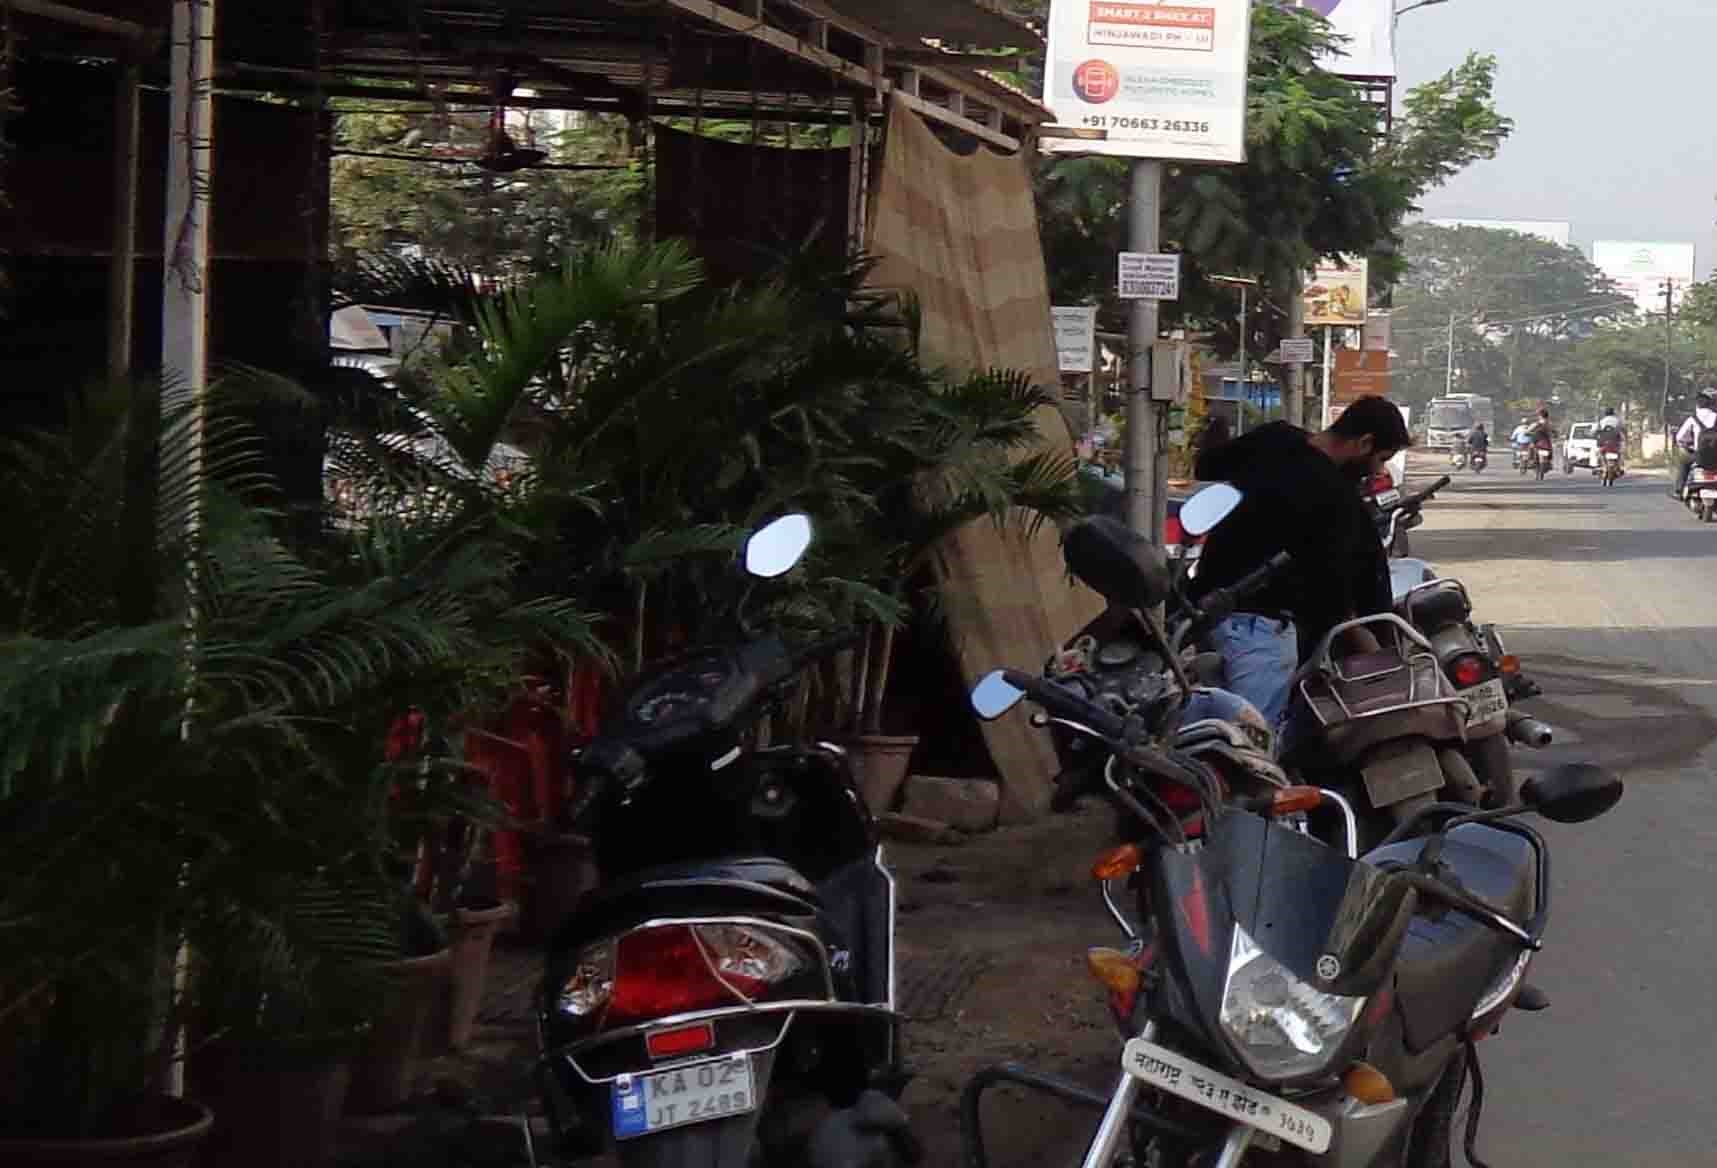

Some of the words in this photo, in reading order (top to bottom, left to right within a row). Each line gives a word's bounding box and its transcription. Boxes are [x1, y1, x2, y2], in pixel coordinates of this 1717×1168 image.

[1082, 116, 1106, 127] +91
[1111, 116, 1158, 130] 70663
[1164, 121, 1209, 133] 26336
[654, 1072, 688, 1099] KA
